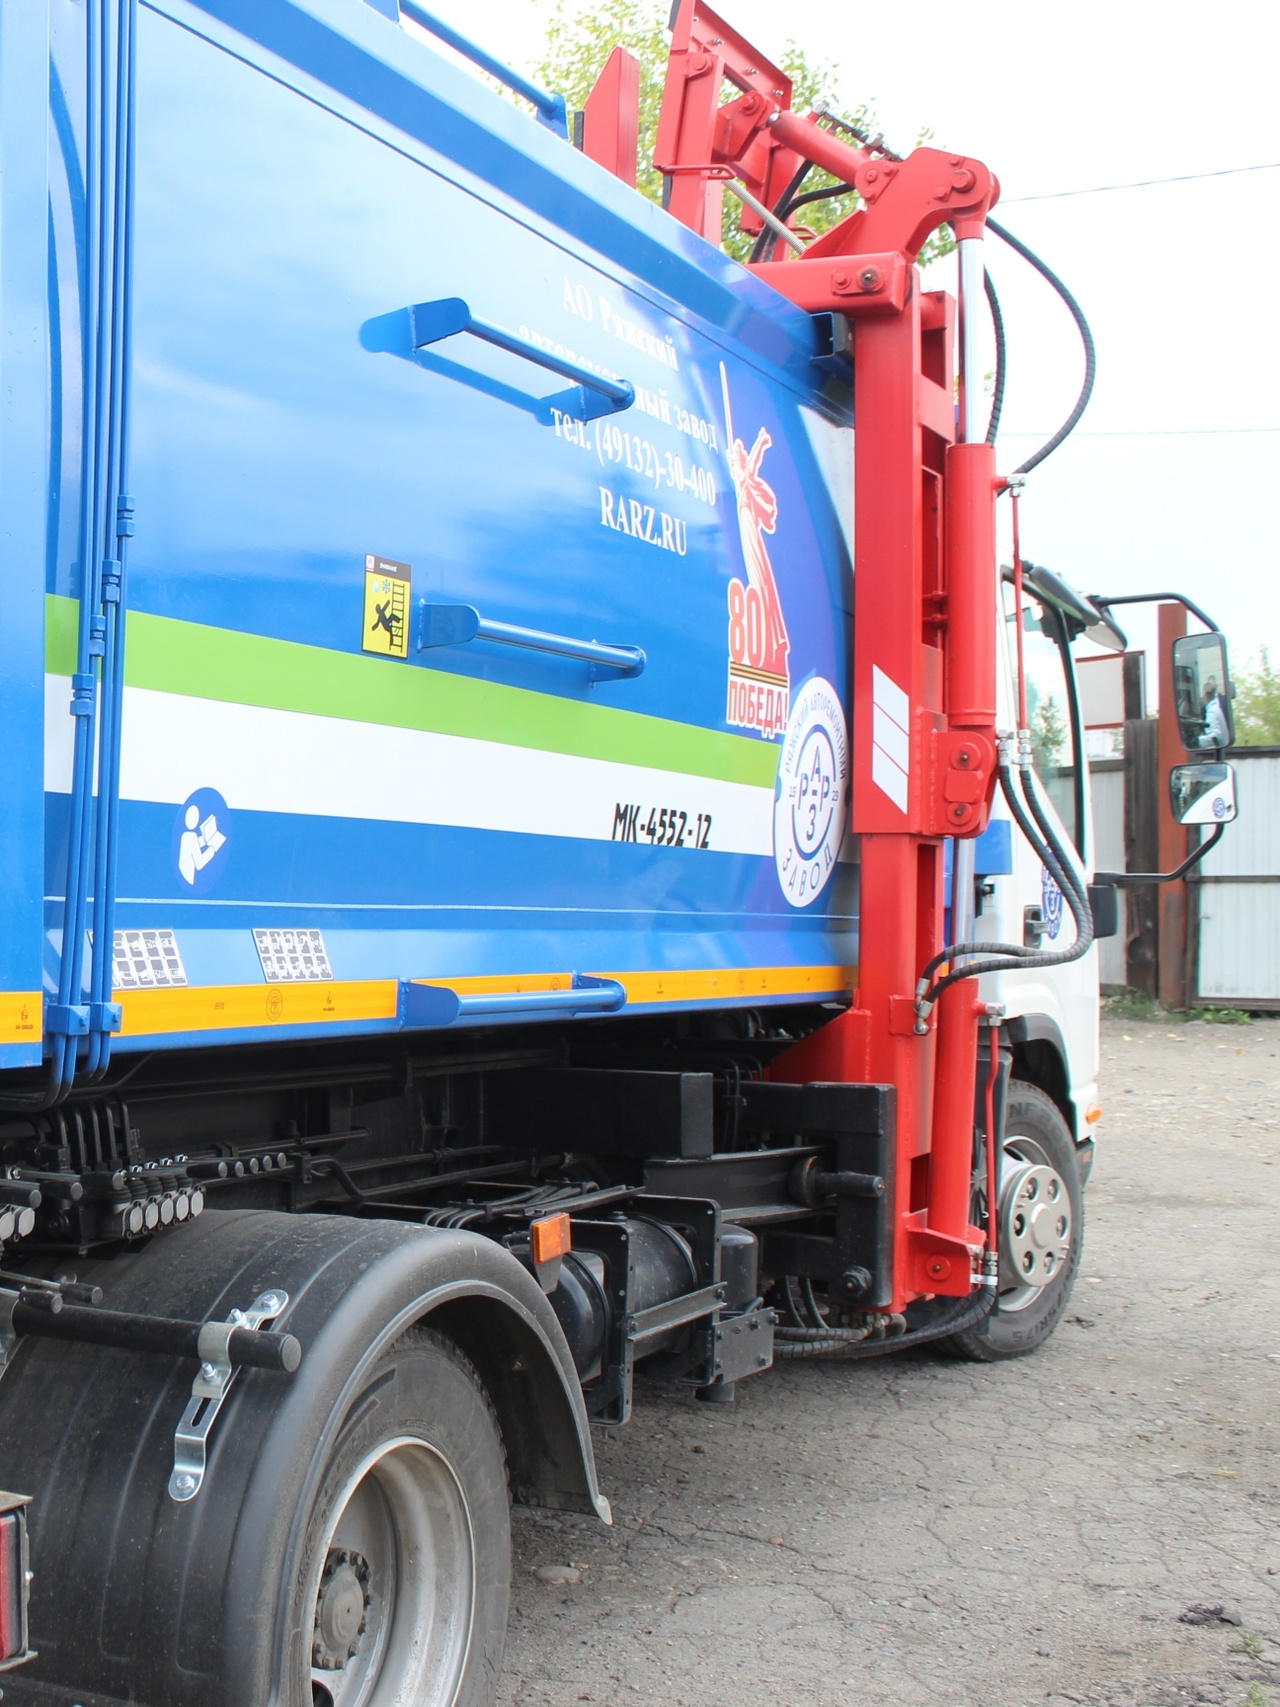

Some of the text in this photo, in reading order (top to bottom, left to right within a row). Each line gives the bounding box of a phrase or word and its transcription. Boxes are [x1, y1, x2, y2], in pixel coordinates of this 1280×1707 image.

[563, 275, 679, 372] АО Ряжский
[595, 419, 716, 506] (49132)-30-400
[673, 405, 719, 455] завод
[598, 486, 687, 556] RARZ.RU
[728, 579, 765, 668] 80
[728, 679, 788, 736] ПОБЕДА!
[782, 843, 832, 897] ЗАВОД
